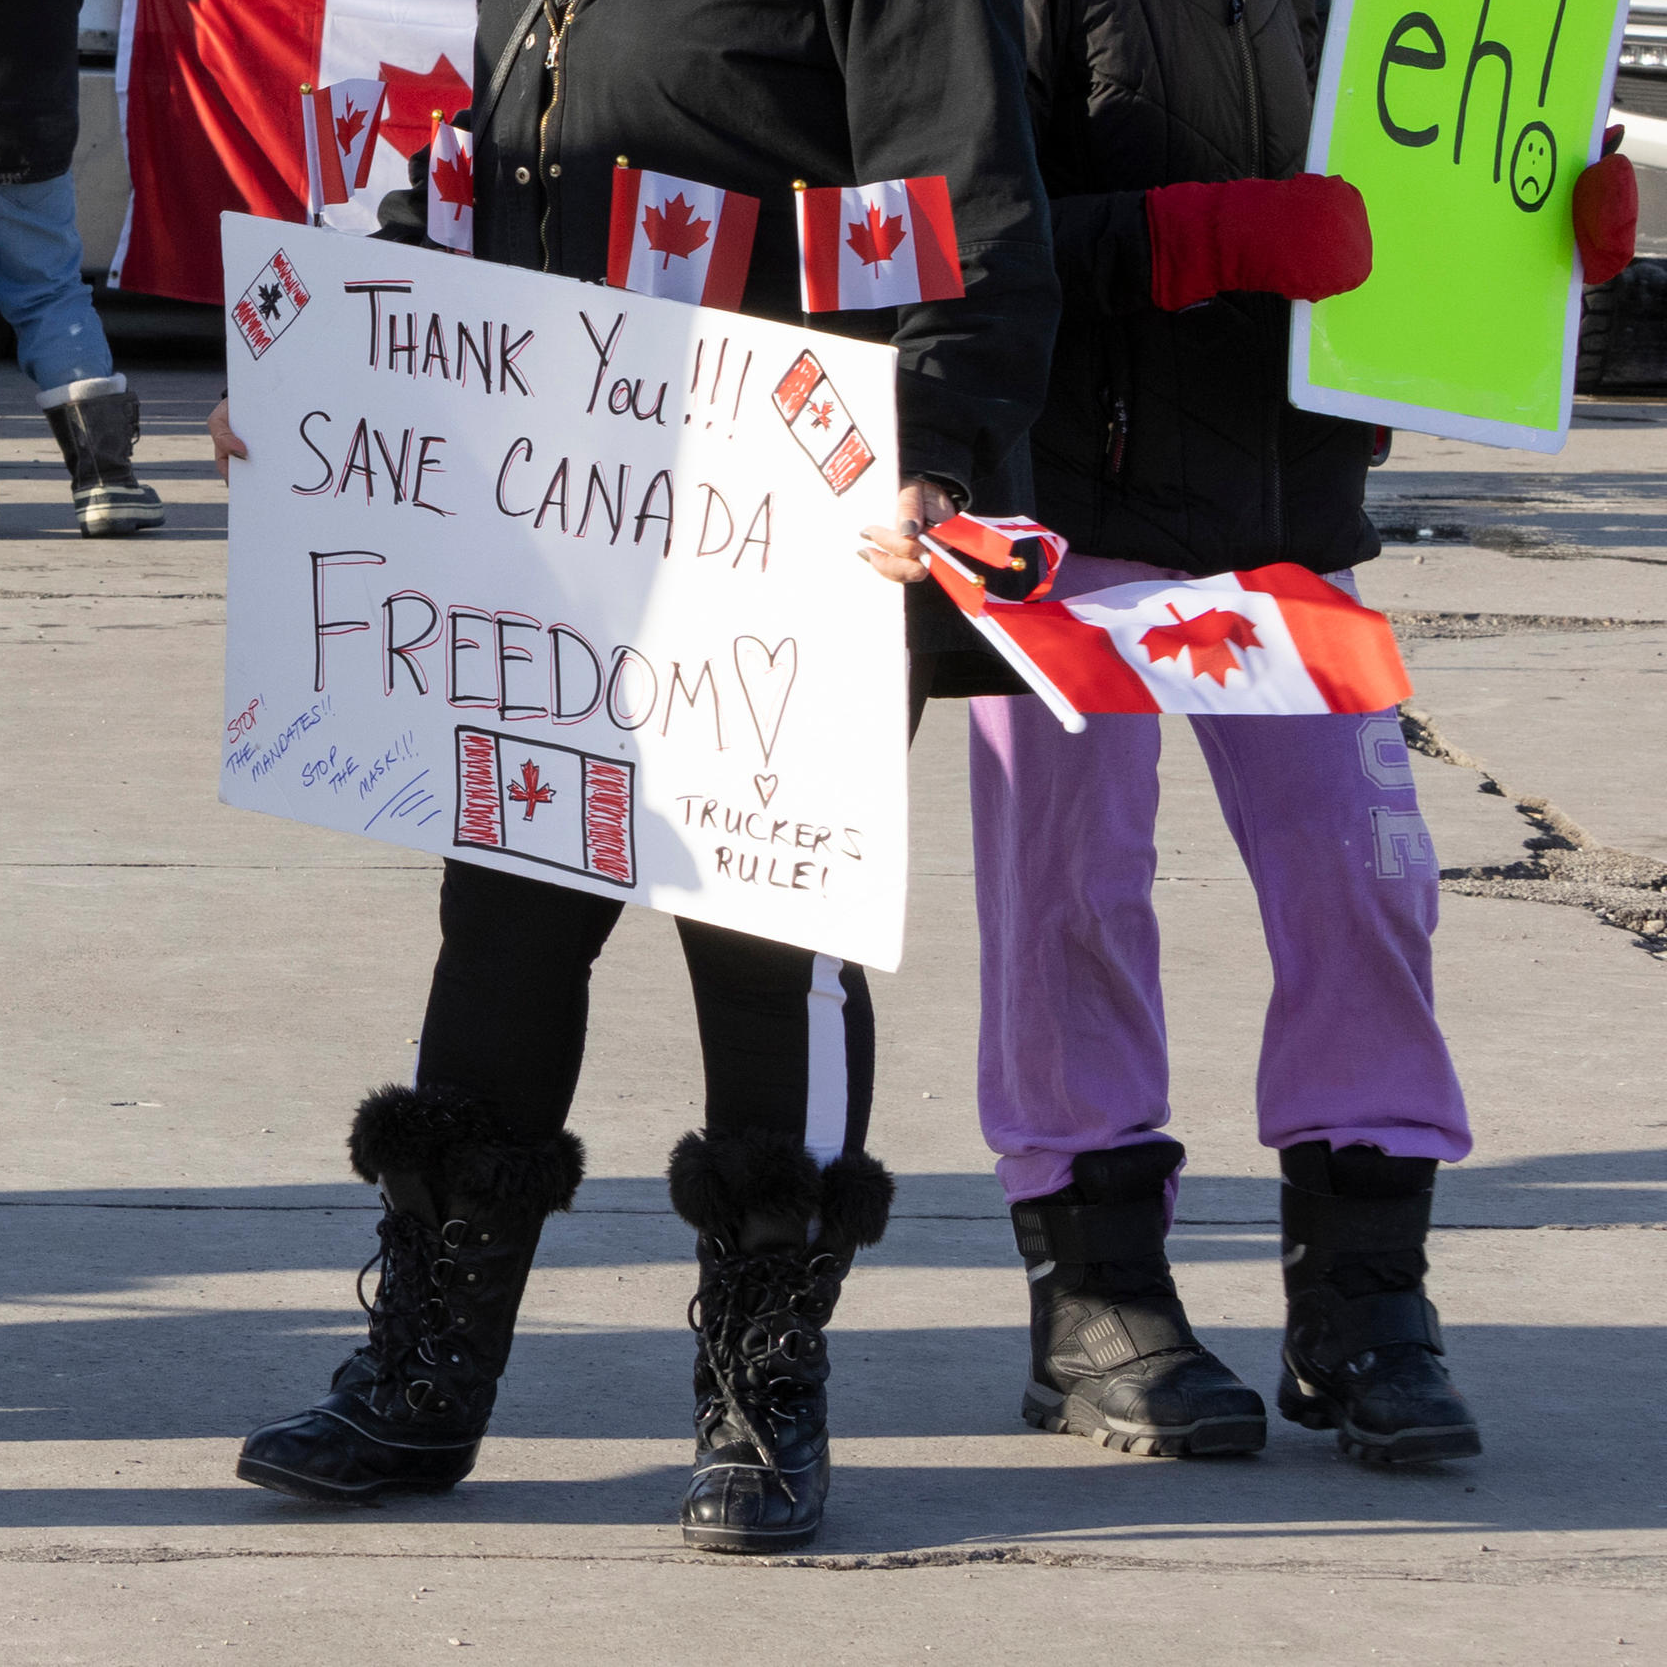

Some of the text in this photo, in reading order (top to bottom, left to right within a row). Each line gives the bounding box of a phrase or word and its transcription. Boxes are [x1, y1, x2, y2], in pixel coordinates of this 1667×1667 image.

[343, 279, 536, 398] THANK
[291, 411, 777, 573] SAVE CANADA
[308, 550, 730, 753] FREEDOM
[226, 742, 258, 775] THE
[301, 745, 337, 787] STOP
[329, 756, 360, 794] THE
[676, 795, 864, 861] TRUCKERS
[715, 846, 829, 899] RULE!
